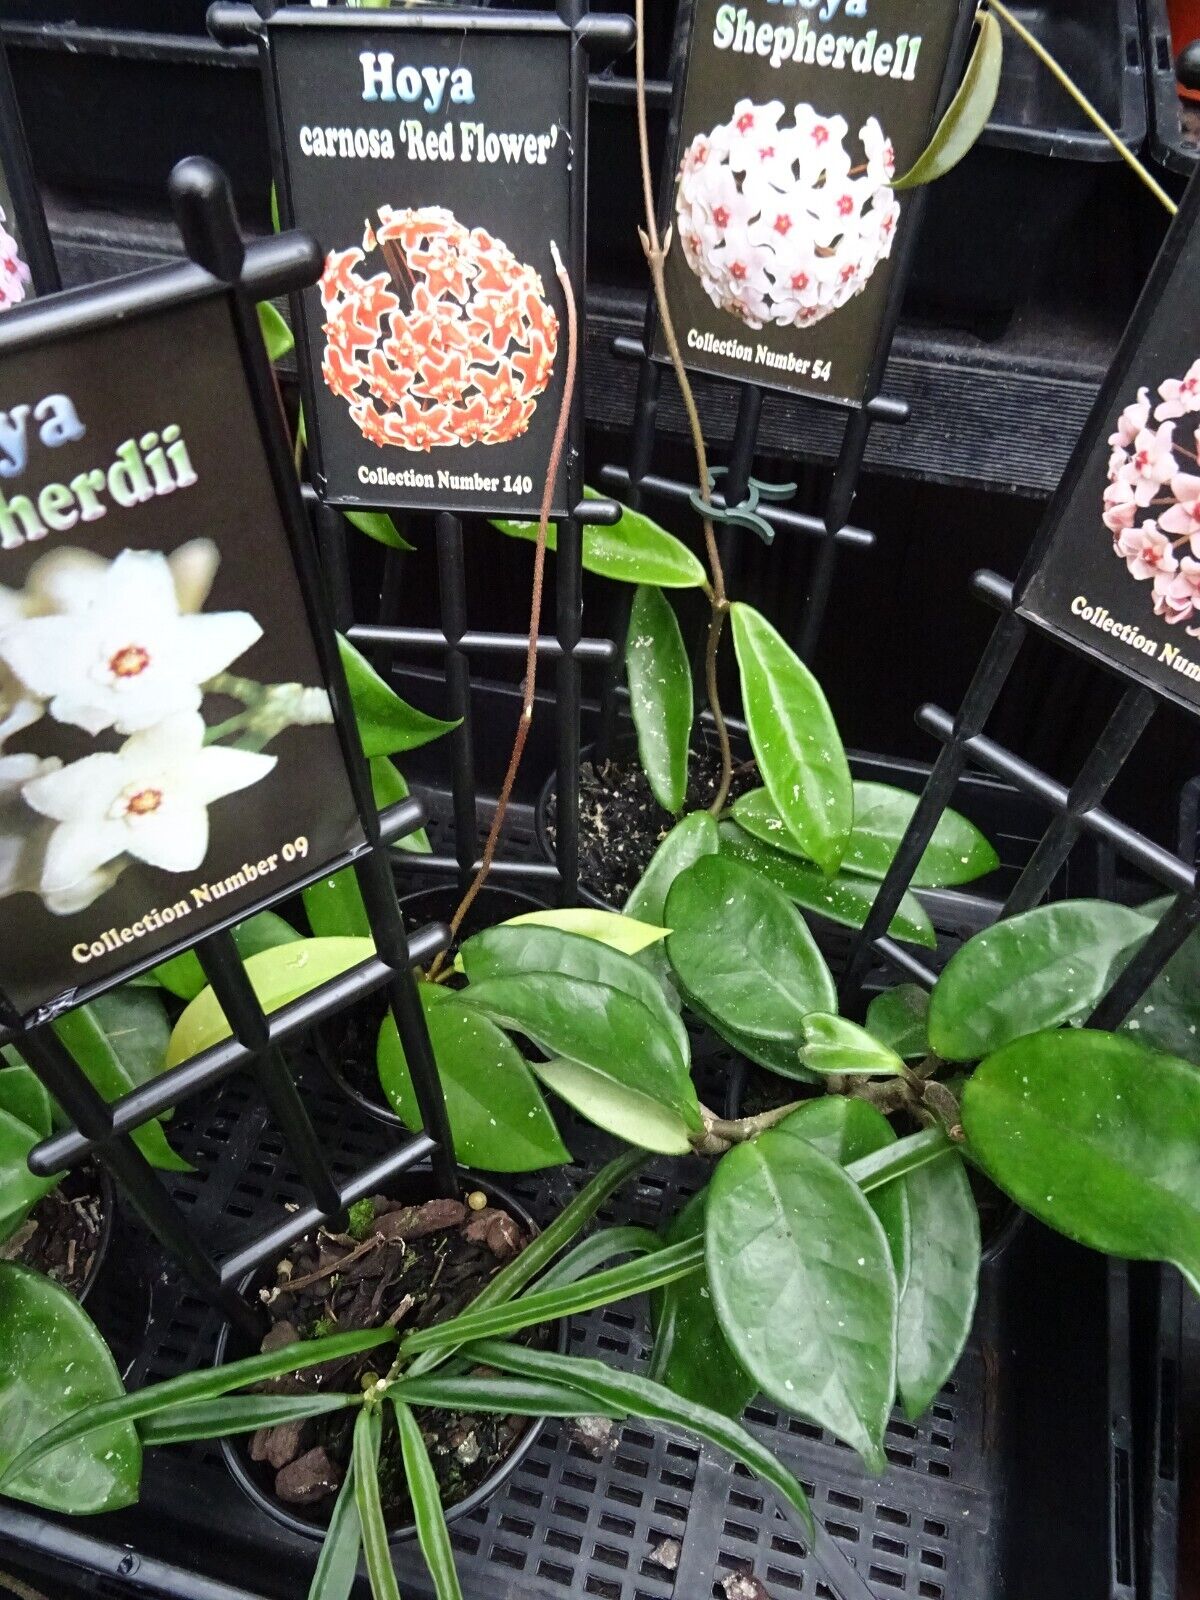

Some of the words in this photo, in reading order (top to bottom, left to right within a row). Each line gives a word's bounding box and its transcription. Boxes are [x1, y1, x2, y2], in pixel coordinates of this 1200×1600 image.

[712, 3, 922, 81] Shepherdell
[358, 51, 476, 113] Hoya
[299, 124, 396, 160] carnosa
[686, 328, 753, 362] Collection
[754, 343, 812, 376] Number
[810, 358, 833, 383] 54
[357, 465, 435, 489] Collection
[436, 470, 500, 493] Number
[502, 474, 533, 496] 140
[1070, 595, 1159, 658] Collection
[70, 898, 193, 965] Collection
[189, 852, 280, 909] Number
[281, 835, 310, 863] 09
